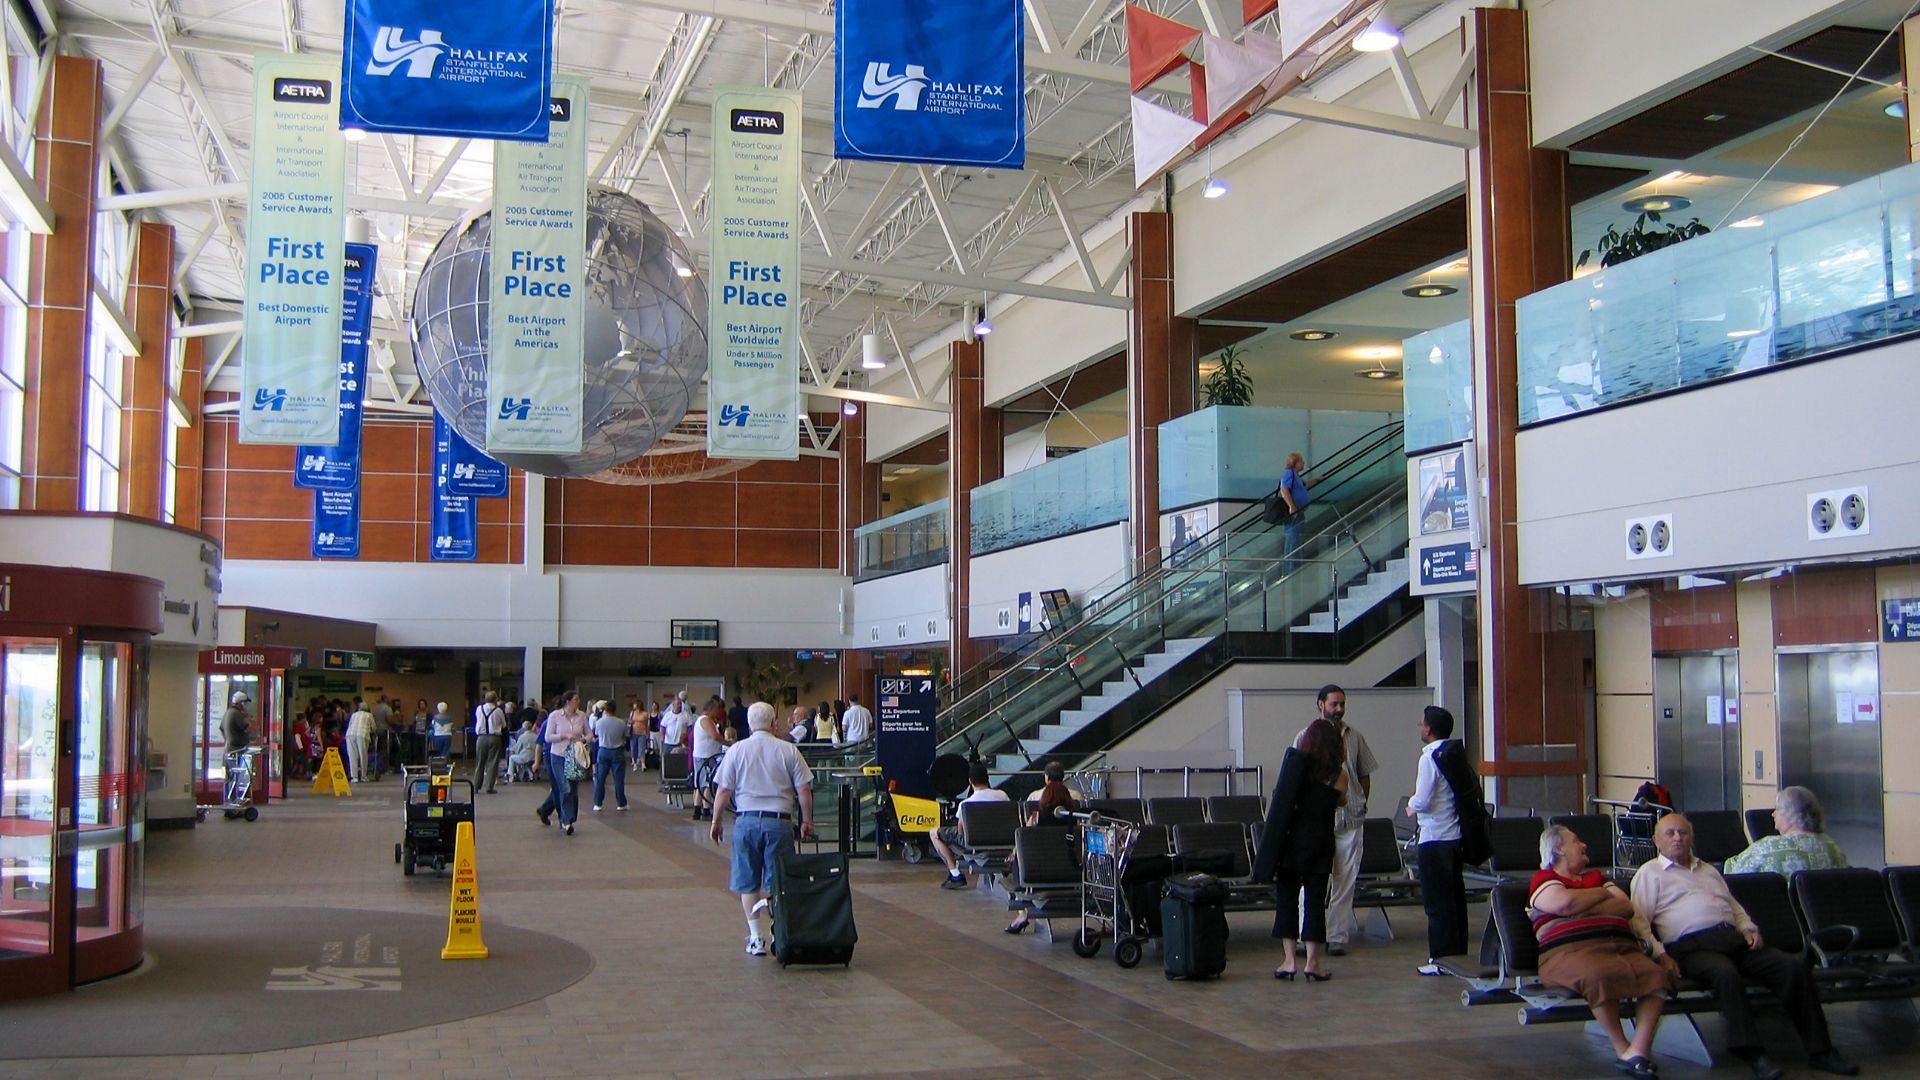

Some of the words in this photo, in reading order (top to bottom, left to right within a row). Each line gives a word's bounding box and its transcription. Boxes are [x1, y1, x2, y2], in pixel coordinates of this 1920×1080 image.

[450, 49, 528, 63] HALIFAX
[446, 59, 504, 70] STANFIELD
[443, 67, 526, 78] INTERNATIONAL
[438, 74, 486, 84] AIRPORT
[280, 85, 324, 97] AETRA
[932, 82, 1003, 96] HALIFAX
[929, 92, 982, 101] STANFIELD
[927, 99, 1003, 110] INTERNATIONAL
[924, 106, 966, 115] AIRPORT
[274, 111, 299, 120] Airport
[302, 112, 328, 121] Council
[737, 116, 778, 128] AETRA
[277, 124, 324, 132] International
[732, 141, 755, 150] Airport
[276, 147, 323, 155] International
[735, 153, 778, 161] International
[288, 159, 322, 168] Transport
[518, 162, 563, 171] International
[529, 174, 562, 183] Transport
[735, 175, 778, 183] International
[520, 185, 560, 193] Association
[746, 186, 778, 195] Transport
[288, 192, 333, 202] Customer
[737, 196, 775, 205] Association
[262, 203, 296, 213] Service
[298, 205, 333, 214] Awards
[530, 208, 573, 217] Customer
[505, 218, 537, 227] Service
[540, 219, 573, 229] Awards
[748, 218, 789, 228] Customer
[724, 229, 755, 237] Service
[757, 230, 789, 239] Awards
[268, 237, 324, 259] First
[344, 259, 360, 268] TRA
[512, 251, 565, 272] First
[260, 263, 330, 285] Place
[730, 261, 781, 282] First
[505, 276, 571, 297] Place
[723, 286, 787, 307] Place
[258, 303, 279, 312] Best
[283, 304, 329, 313] Domestic
[275, 316, 311, 326] Airport
[508, 315, 528, 324] Best
[531, 316, 565, 325] Airport
[523, 327, 532, 336] in
[535, 328, 550, 336] the
[727, 324, 747, 332] Best
[749, 324, 782, 334] Airport
[515, 339, 558, 349] Americas
[729, 336, 779, 345] Worldwide
[734, 360, 774, 369] Passengers
[214, 650, 264, 665] Limousine
[901, 815, 915, 825] CART
